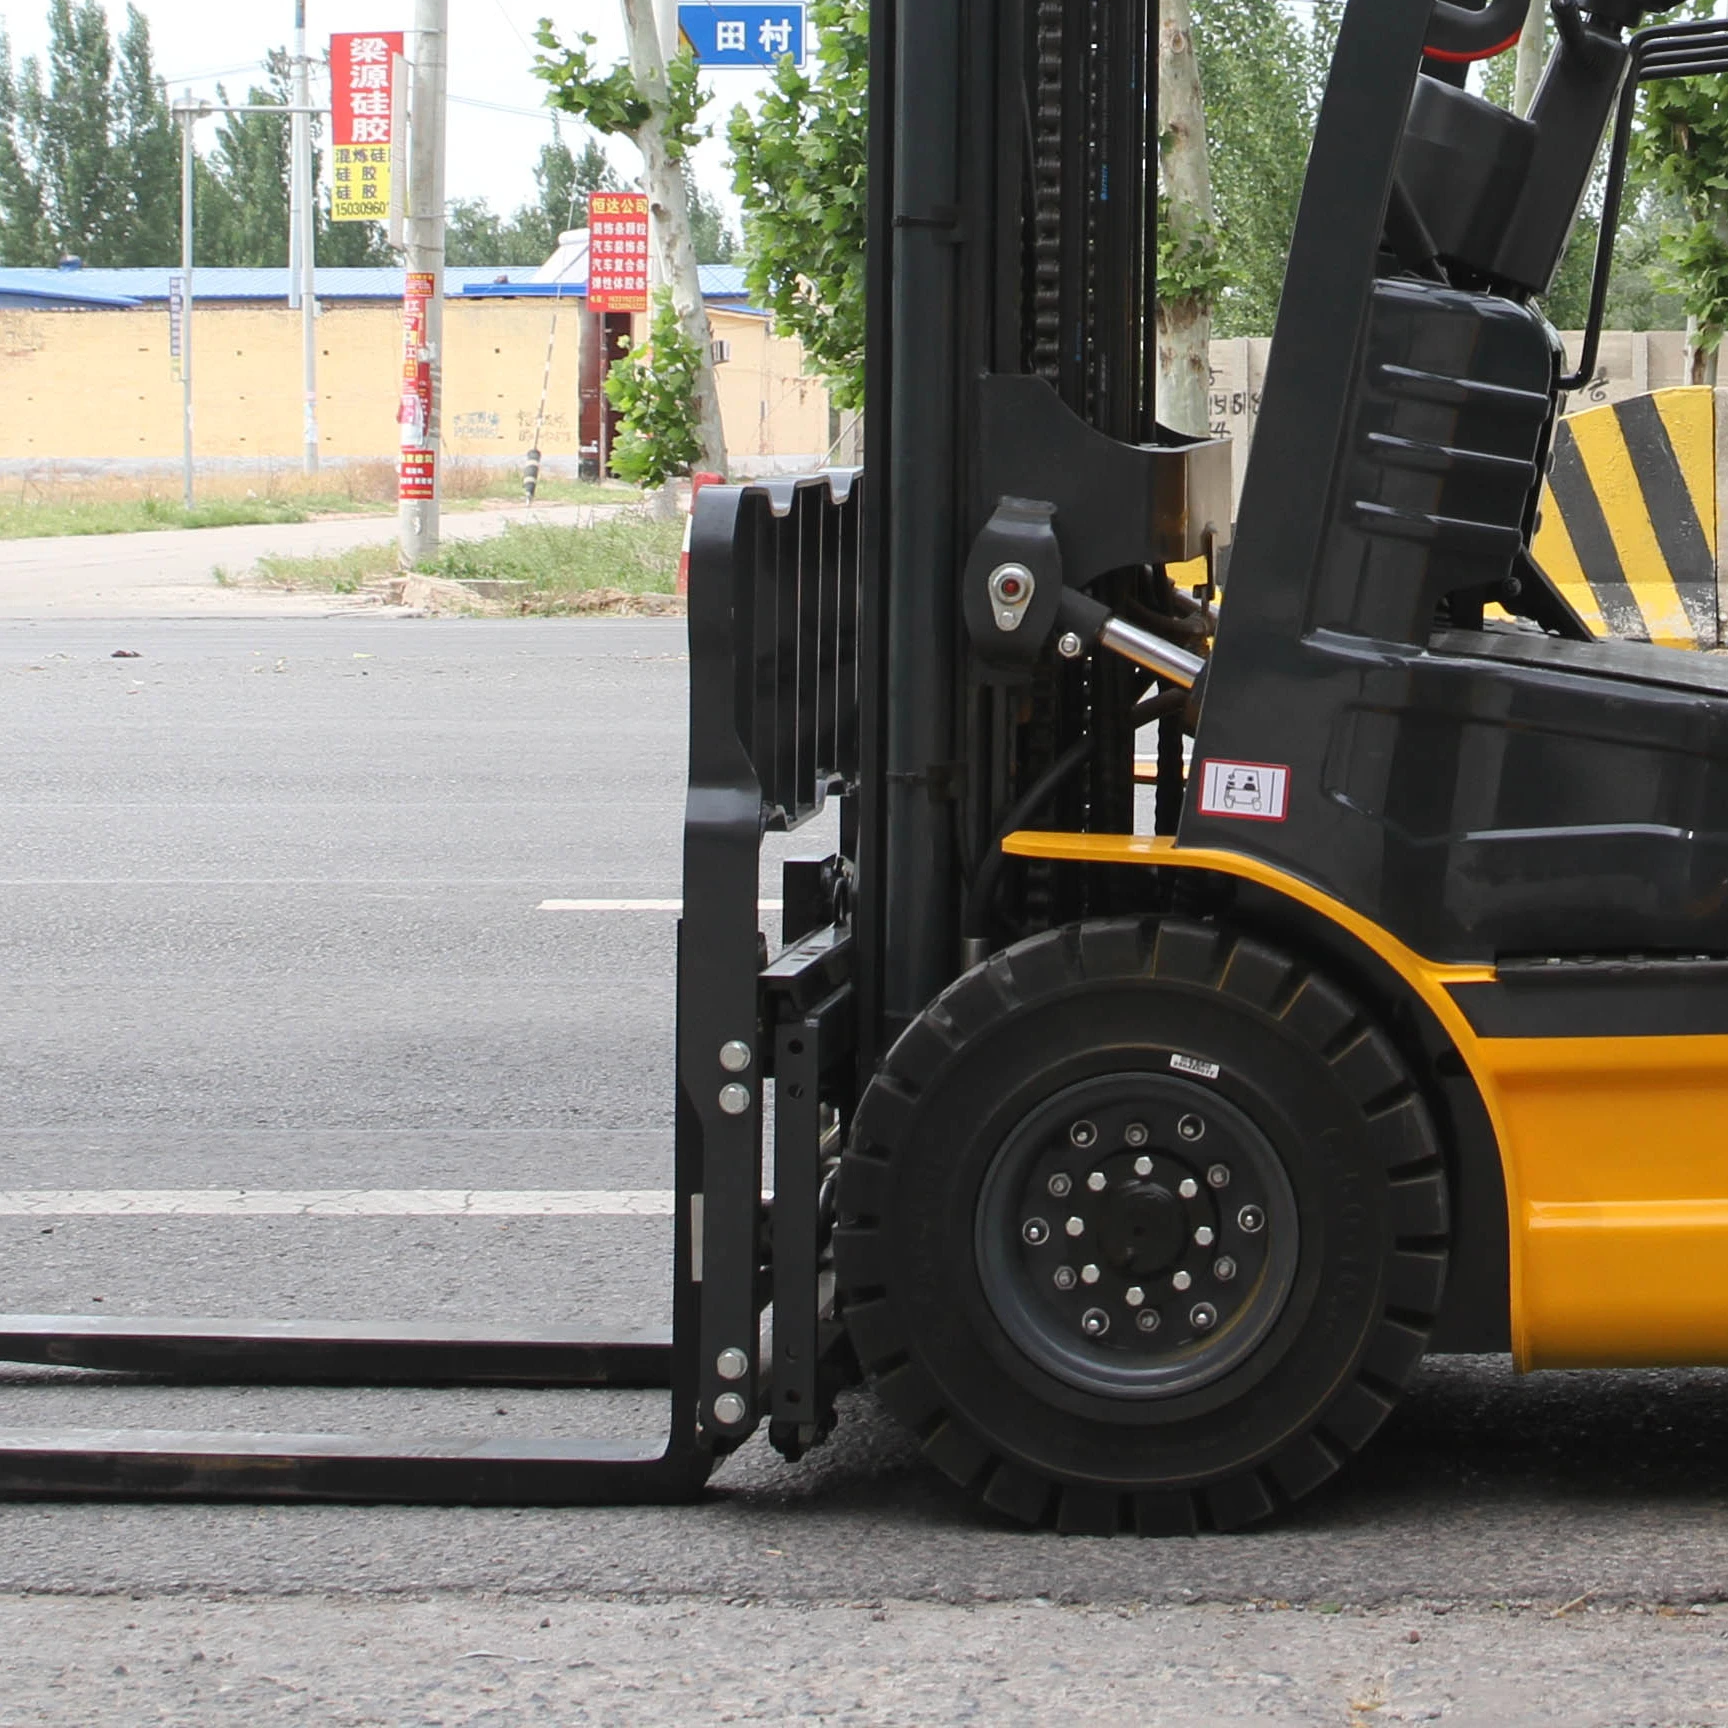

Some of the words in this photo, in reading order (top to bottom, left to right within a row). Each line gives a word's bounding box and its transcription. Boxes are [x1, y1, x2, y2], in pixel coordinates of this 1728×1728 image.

[716, 18, 793, 53] 田村
[349, 37, 390, 143] 梁源硅胶
[335, 146, 391, 164] 混炼硅
[335, 201, 390, 216] 15030960
[591, 196, 649, 215] 恒达公司
